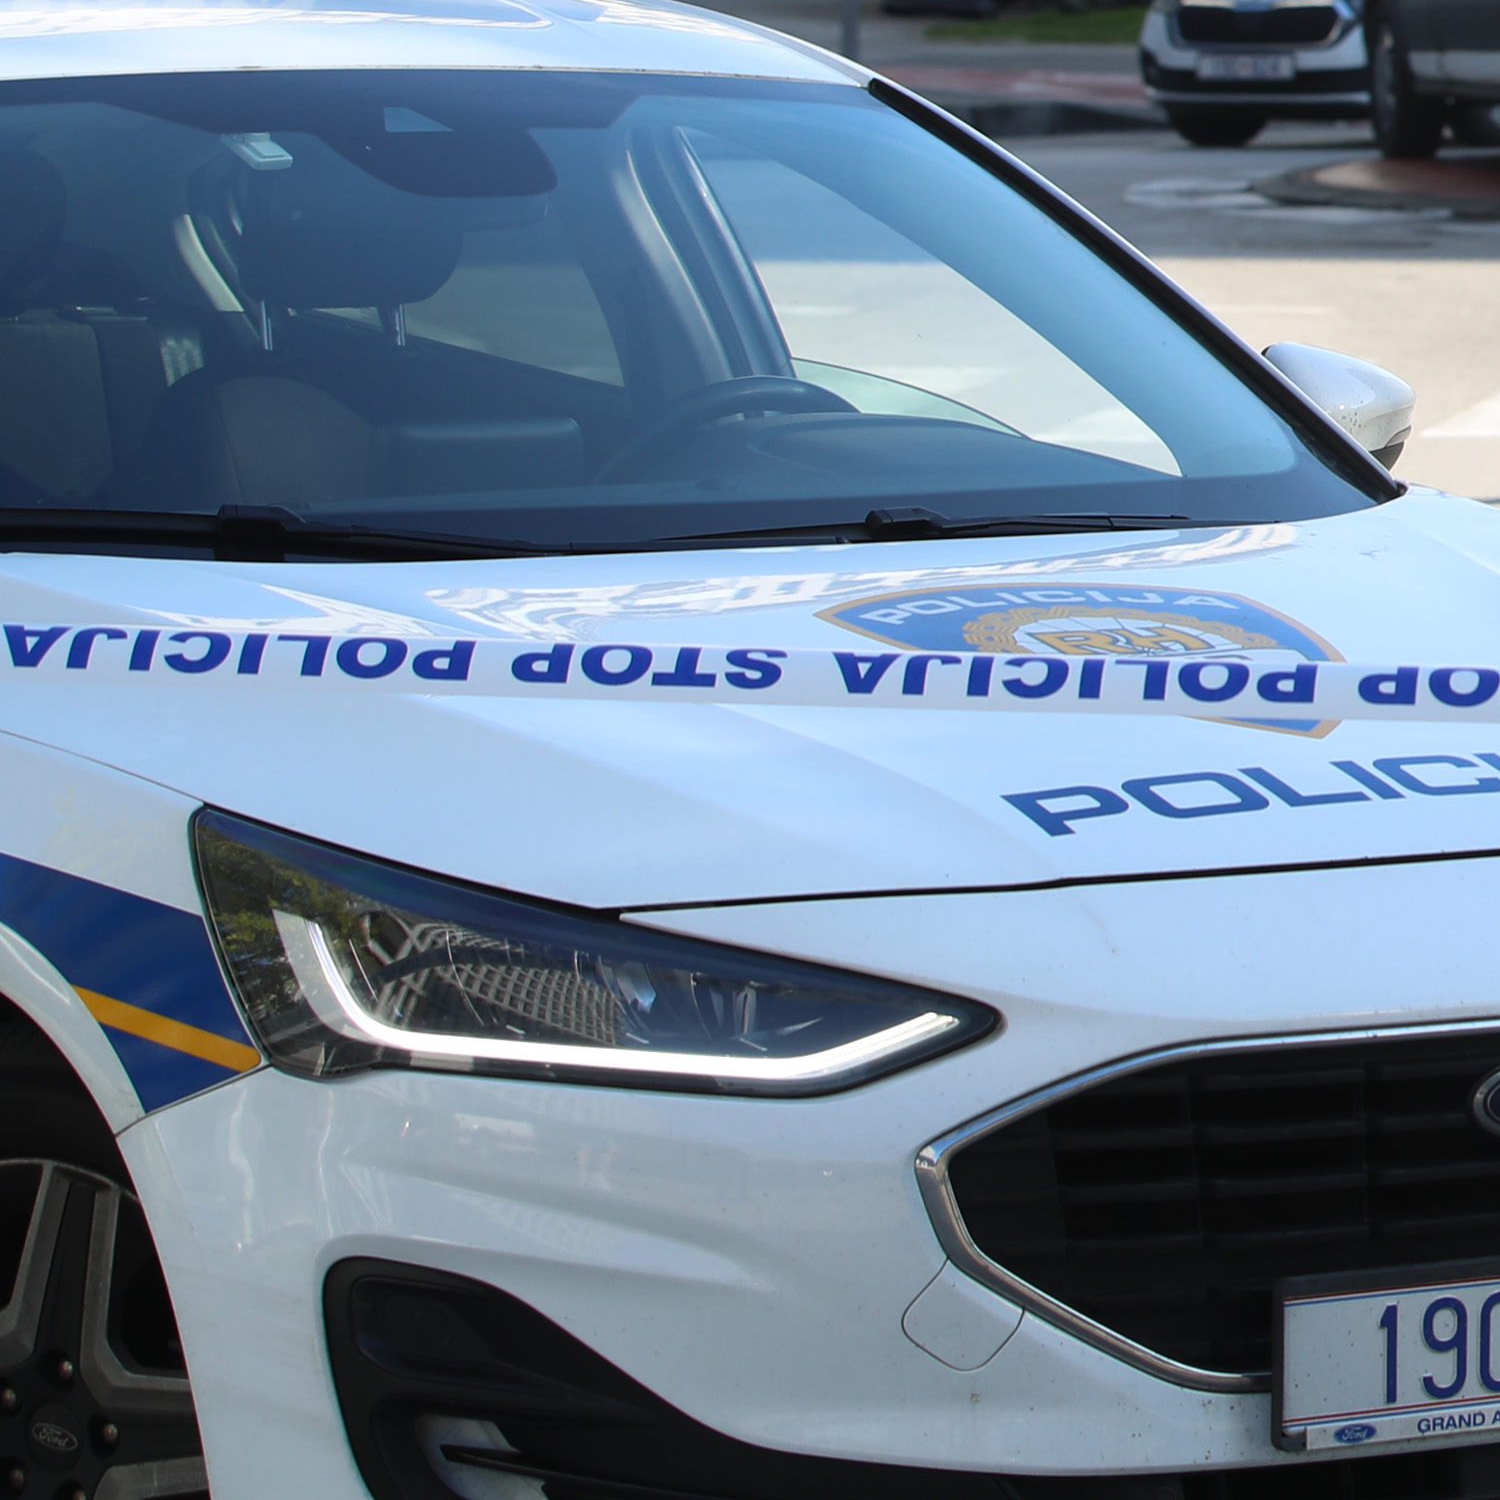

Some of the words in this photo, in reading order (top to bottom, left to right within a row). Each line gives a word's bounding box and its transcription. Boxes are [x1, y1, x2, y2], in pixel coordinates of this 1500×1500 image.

[858, 590, 1241, 625] POLICIJA
[4, 625, 475, 681] POLICIJA
[1028, 627, 1216, 656] RH
[512, 645, 787, 689] STOP
[834, 652, 1317, 703] POLICIJA
[1340, 1426, 1369, 1442] Ford
[1416, 1411, 1486, 1434] GRAND
